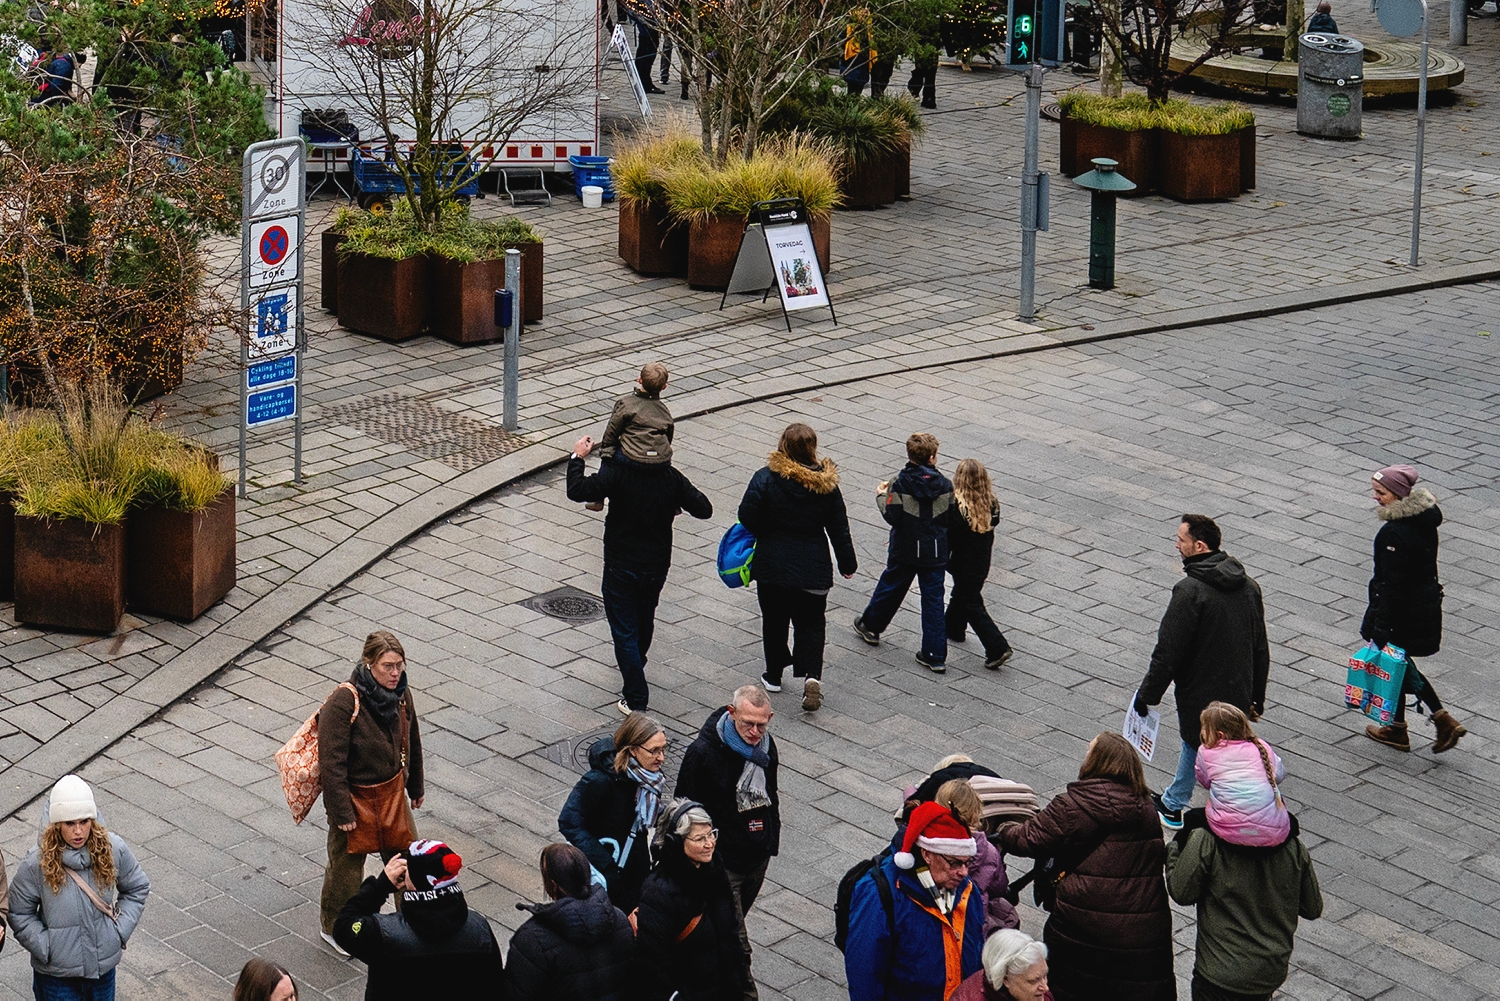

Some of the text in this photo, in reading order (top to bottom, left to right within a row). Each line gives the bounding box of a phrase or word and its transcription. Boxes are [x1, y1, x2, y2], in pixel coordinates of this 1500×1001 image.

[1021, 16, 1031, 32] 6
[265, 166, 285, 183] 30
[263, 198, 286, 209] Zone
[262, 268, 285, 280] Zone
[261, 339, 284, 350] Zone
[251, 365, 273, 375] Cykling
[262, 372, 277, 380] dage
[403, 888, 438, 901] ISLAND
